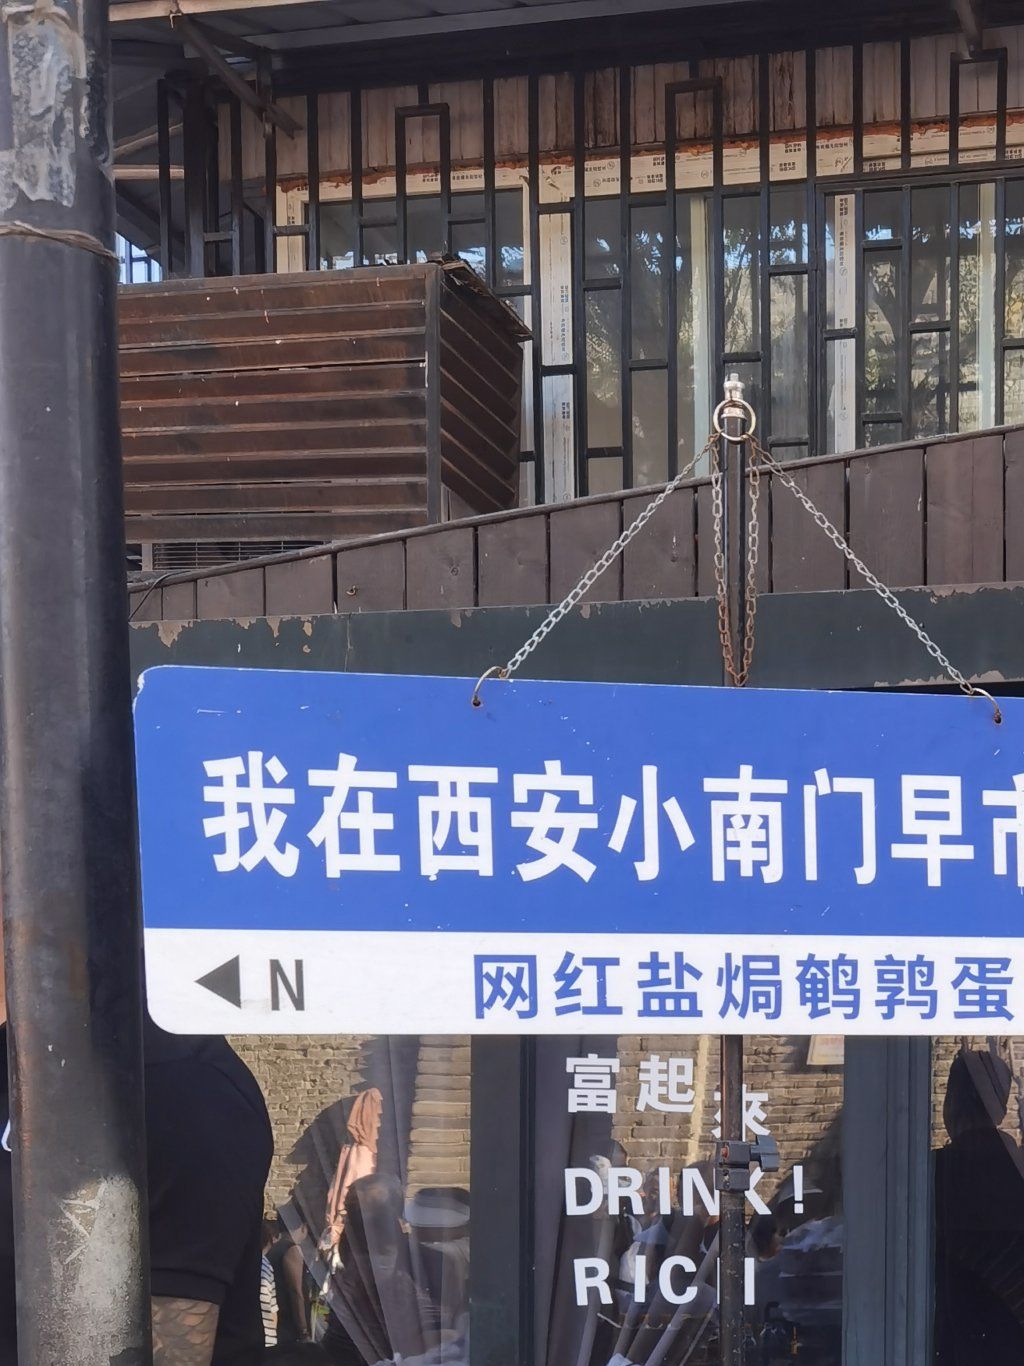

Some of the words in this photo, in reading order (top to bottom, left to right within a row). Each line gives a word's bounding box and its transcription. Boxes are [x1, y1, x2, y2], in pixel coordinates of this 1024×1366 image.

[270, 957, 305, 1012] N
[474, 951, 1015, 1021] 网红盐焗鹌鹑蛋
